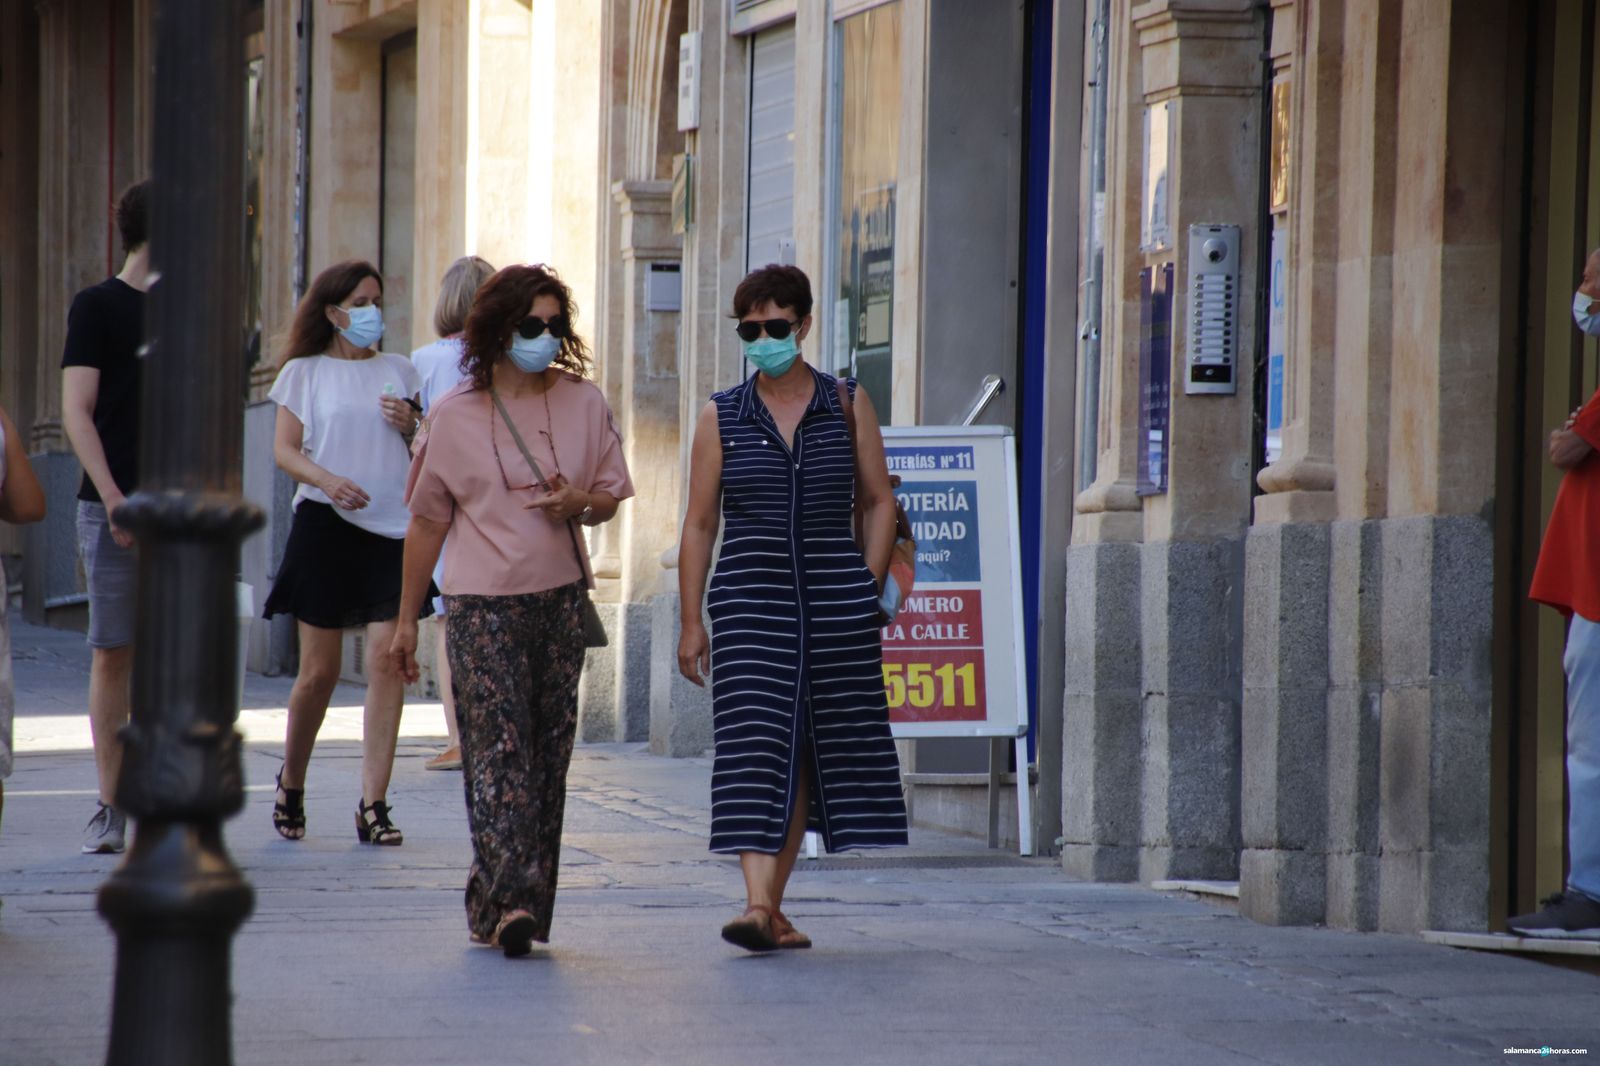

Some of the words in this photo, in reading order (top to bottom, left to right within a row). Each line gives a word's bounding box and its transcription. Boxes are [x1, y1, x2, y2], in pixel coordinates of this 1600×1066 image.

[886, 453, 936, 470] OTERÍAS
[956, 452, 972, 468] 11
[897, 487, 969, 512] OTERÍA
[917, 549, 951, 564] aquí?
[882, 624, 906, 640] LA
[911, 623, 970, 640] CALLE
